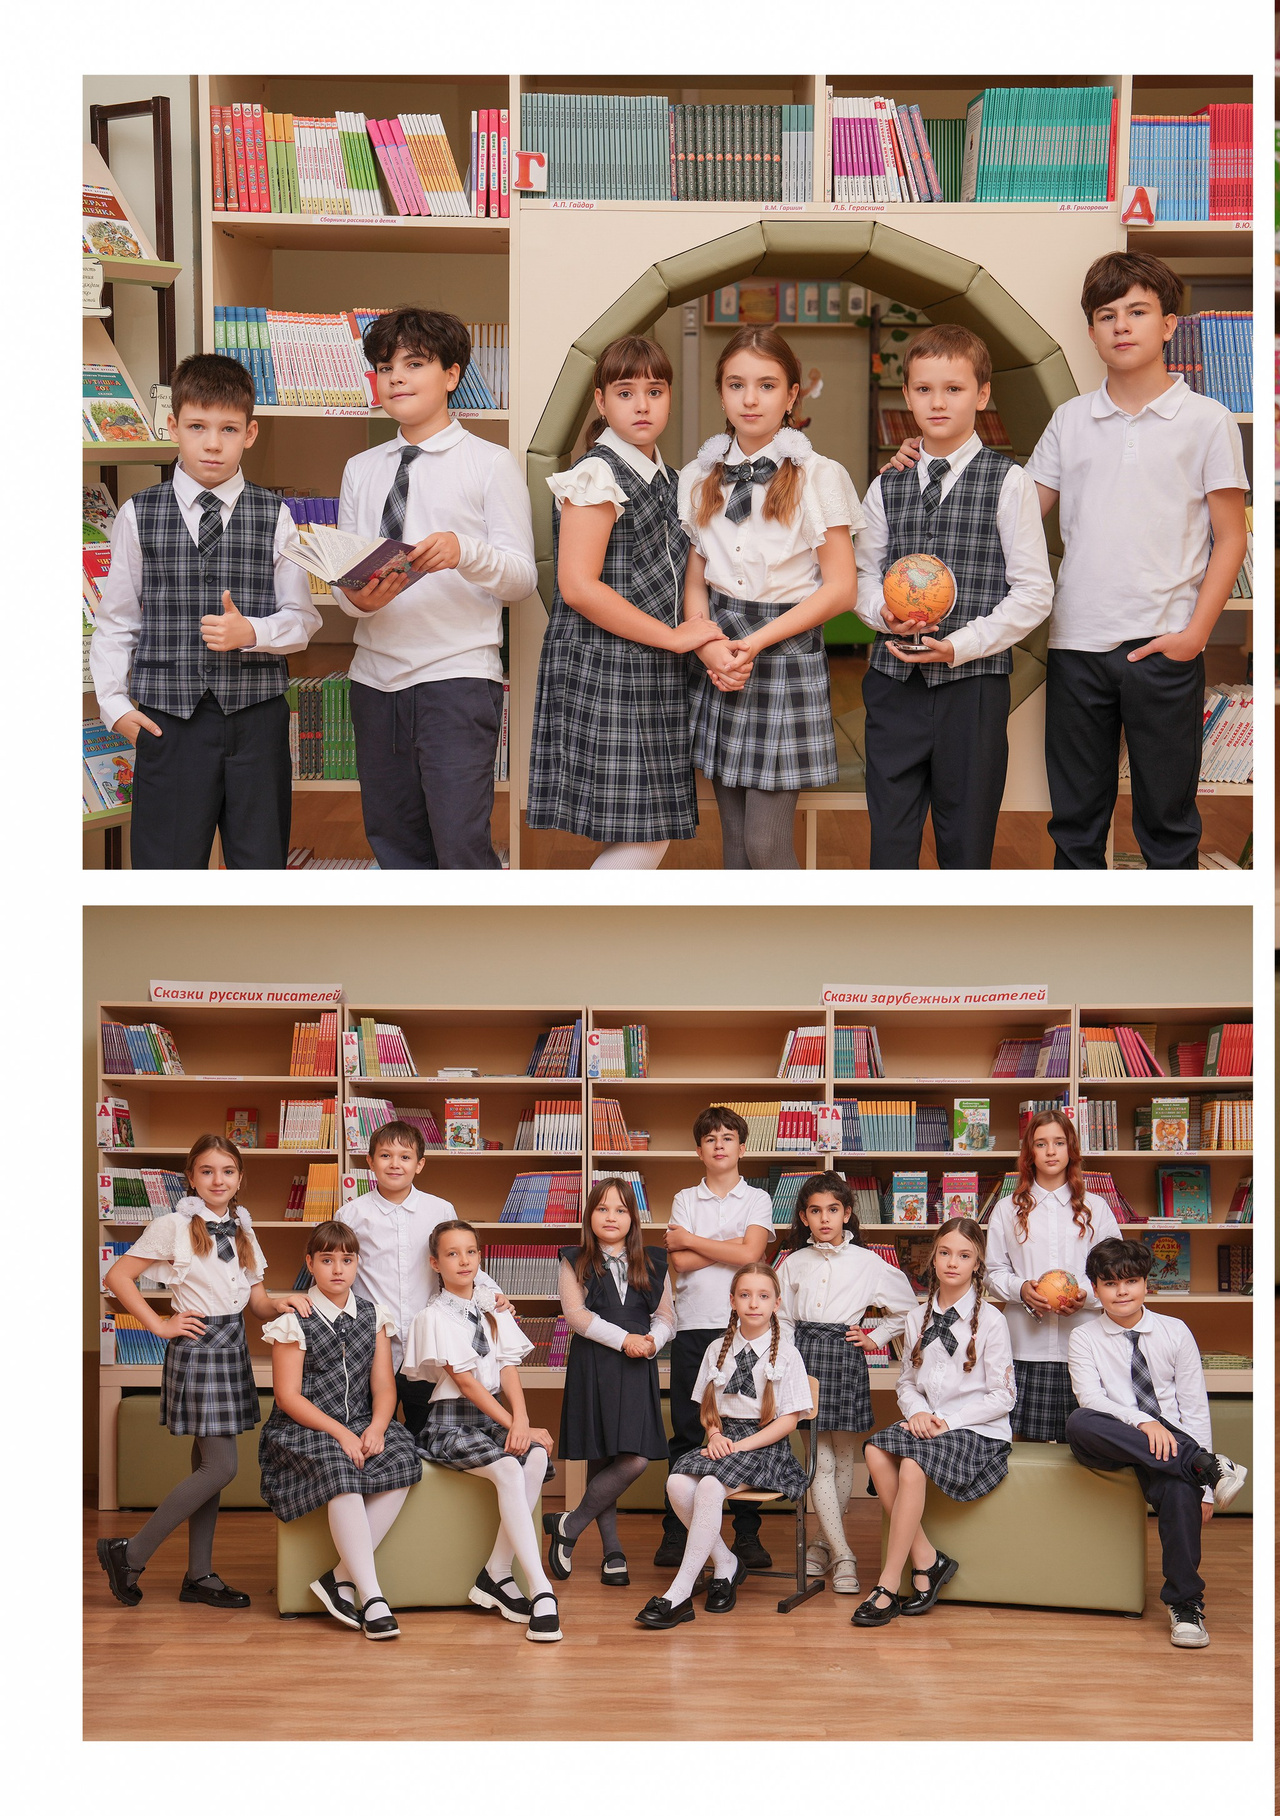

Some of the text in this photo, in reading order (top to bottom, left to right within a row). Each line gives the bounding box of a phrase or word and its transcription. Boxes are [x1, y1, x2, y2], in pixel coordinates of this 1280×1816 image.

[514, 151, 546, 189] Г
[83, 199, 109, 208] ЕРАЯ
[569, 201, 595, 210] Гайдар
[832, 204, 885, 212] Л.Б. Гераскина
[1121, 186, 1155, 225] А
[1211, 720, 1229, 746] РАССКАЗЫ
[1226, 722, 1244, 748] РАССКАЗЫ
[1233, 722, 1250, 748] РАССКАЗЫ
[153, 986, 341, 1003] Сказки русских писателей
[823, 989, 1046, 1006] Сказки зарубежных писателей
[344, 1034, 357, 1046] К
[588, 1033, 600, 1046] С
[97, 1104, 111, 1117] А
[344, 1106, 358, 1118] М
[819, 1107, 830, 1119] Т
[830, 1108, 841, 1120] А
[1064, 1107, 1075, 1119] Б
[99, 1175, 112, 1188] Б
[343, 1176, 356, 1189] О
[101, 1248, 113, 1261] Г
